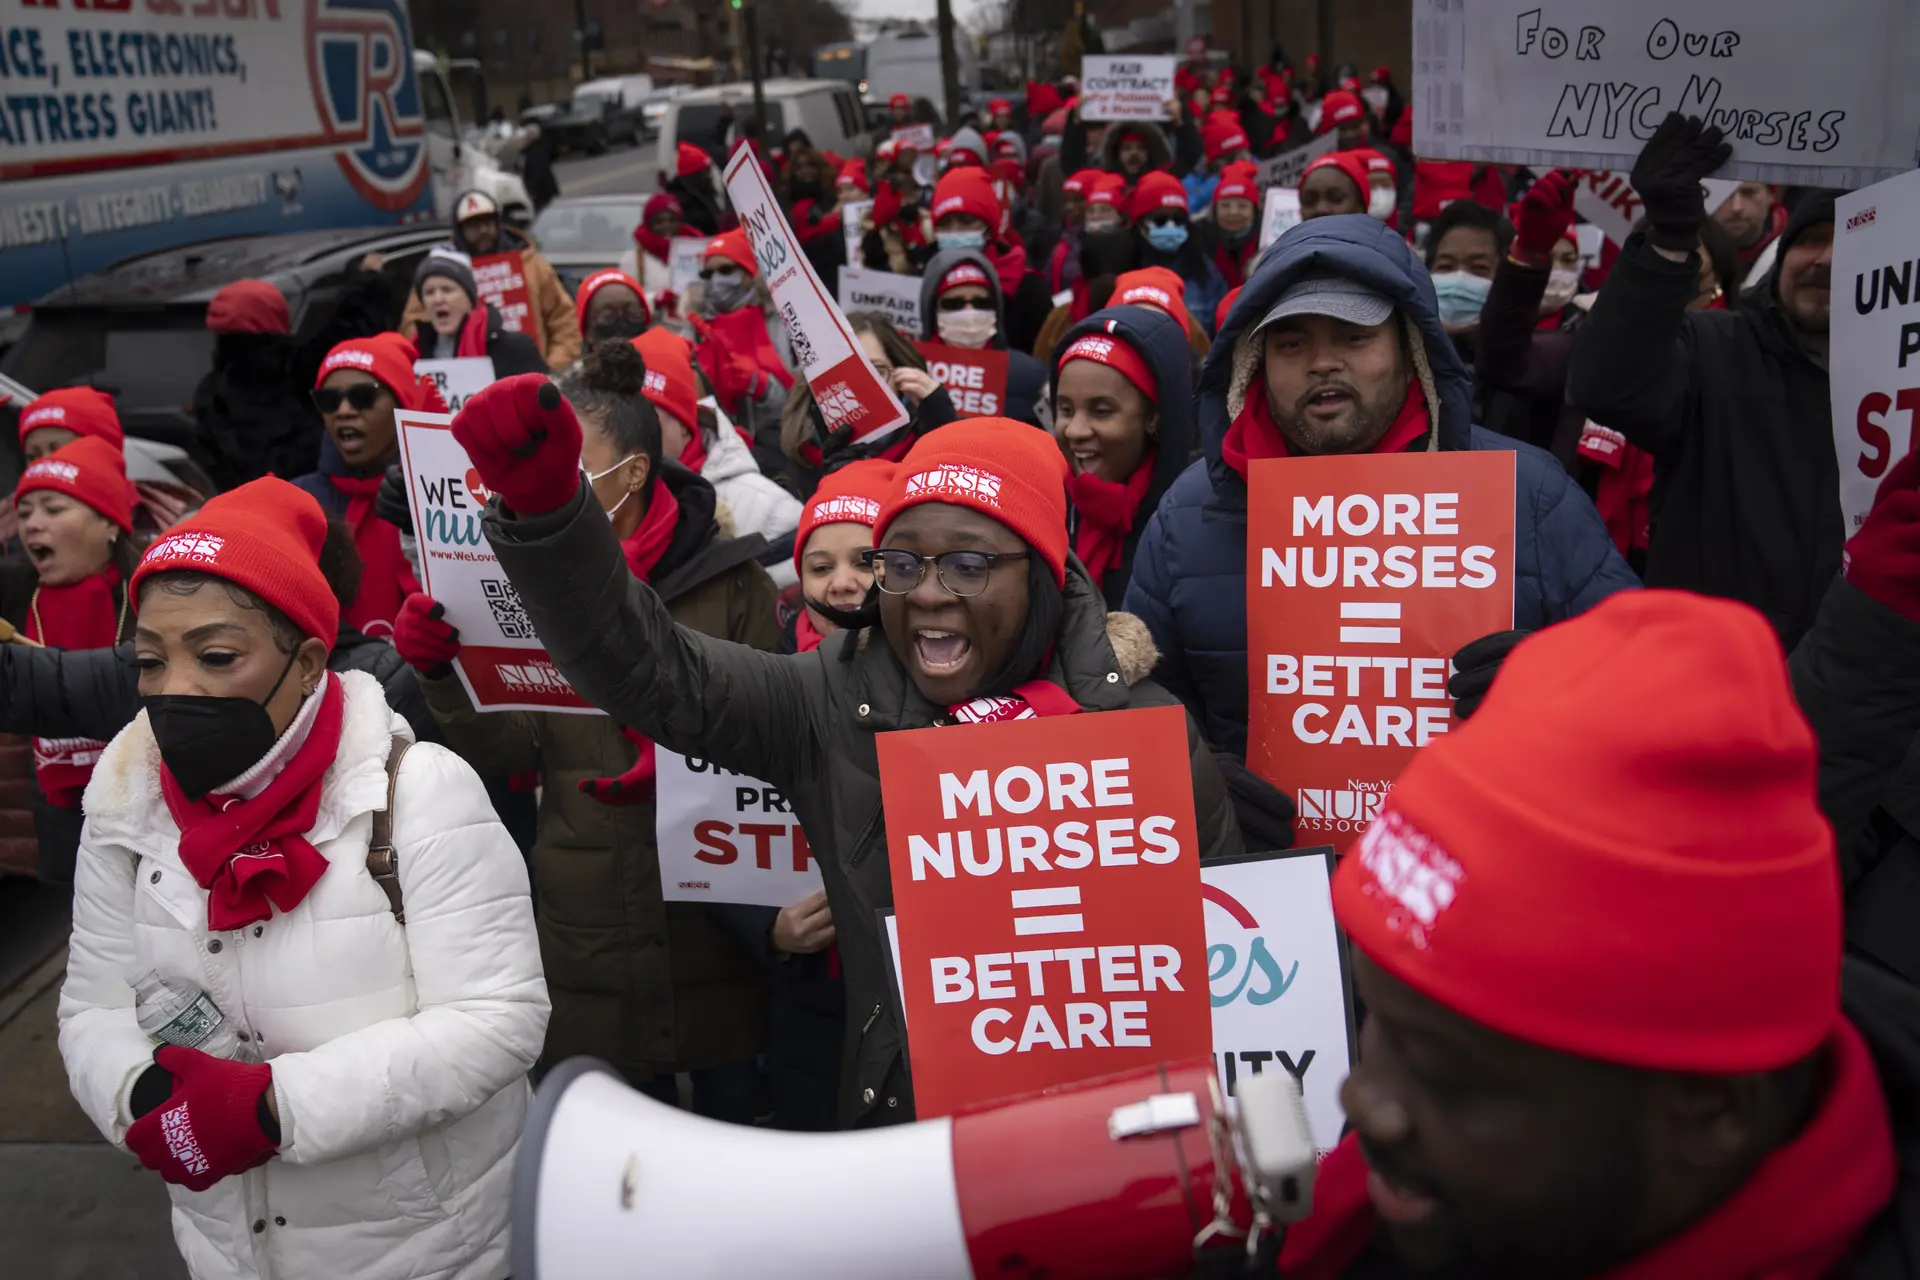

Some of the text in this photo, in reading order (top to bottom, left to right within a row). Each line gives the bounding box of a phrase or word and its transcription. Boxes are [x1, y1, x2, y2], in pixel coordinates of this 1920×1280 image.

[66, 29, 246, 84] ELECTRONICS,
[1086, 77, 1169, 90] CONTRACT
[126, 87, 218, 136] GIANT!
[1547, 82, 1662, 141] NYC
[749, 203, 771, 241] NY
[851, 292, 915, 313] UNFAIR
[905, 470, 1002, 498] NURSES
[938, 463, 959, 472] New
[960, 464, 980, 475] York
[420, 474, 467, 509] WE
[1293, 493, 1459, 536] MORE
[1261, 545, 1497, 589] NURSES
[736, 786, 792, 813] PR
[938, 757, 1134, 820] MORE
[1348, 779, 1379, 792] New
[907, 815, 1181, 882] NURSES
[930, 944, 1185, 1005] BETTER
[970, 1000, 1152, 1055] CARE
[1213, 1049, 1317, 1098] ITY
[166, 1106, 206, 1176] NURSES
